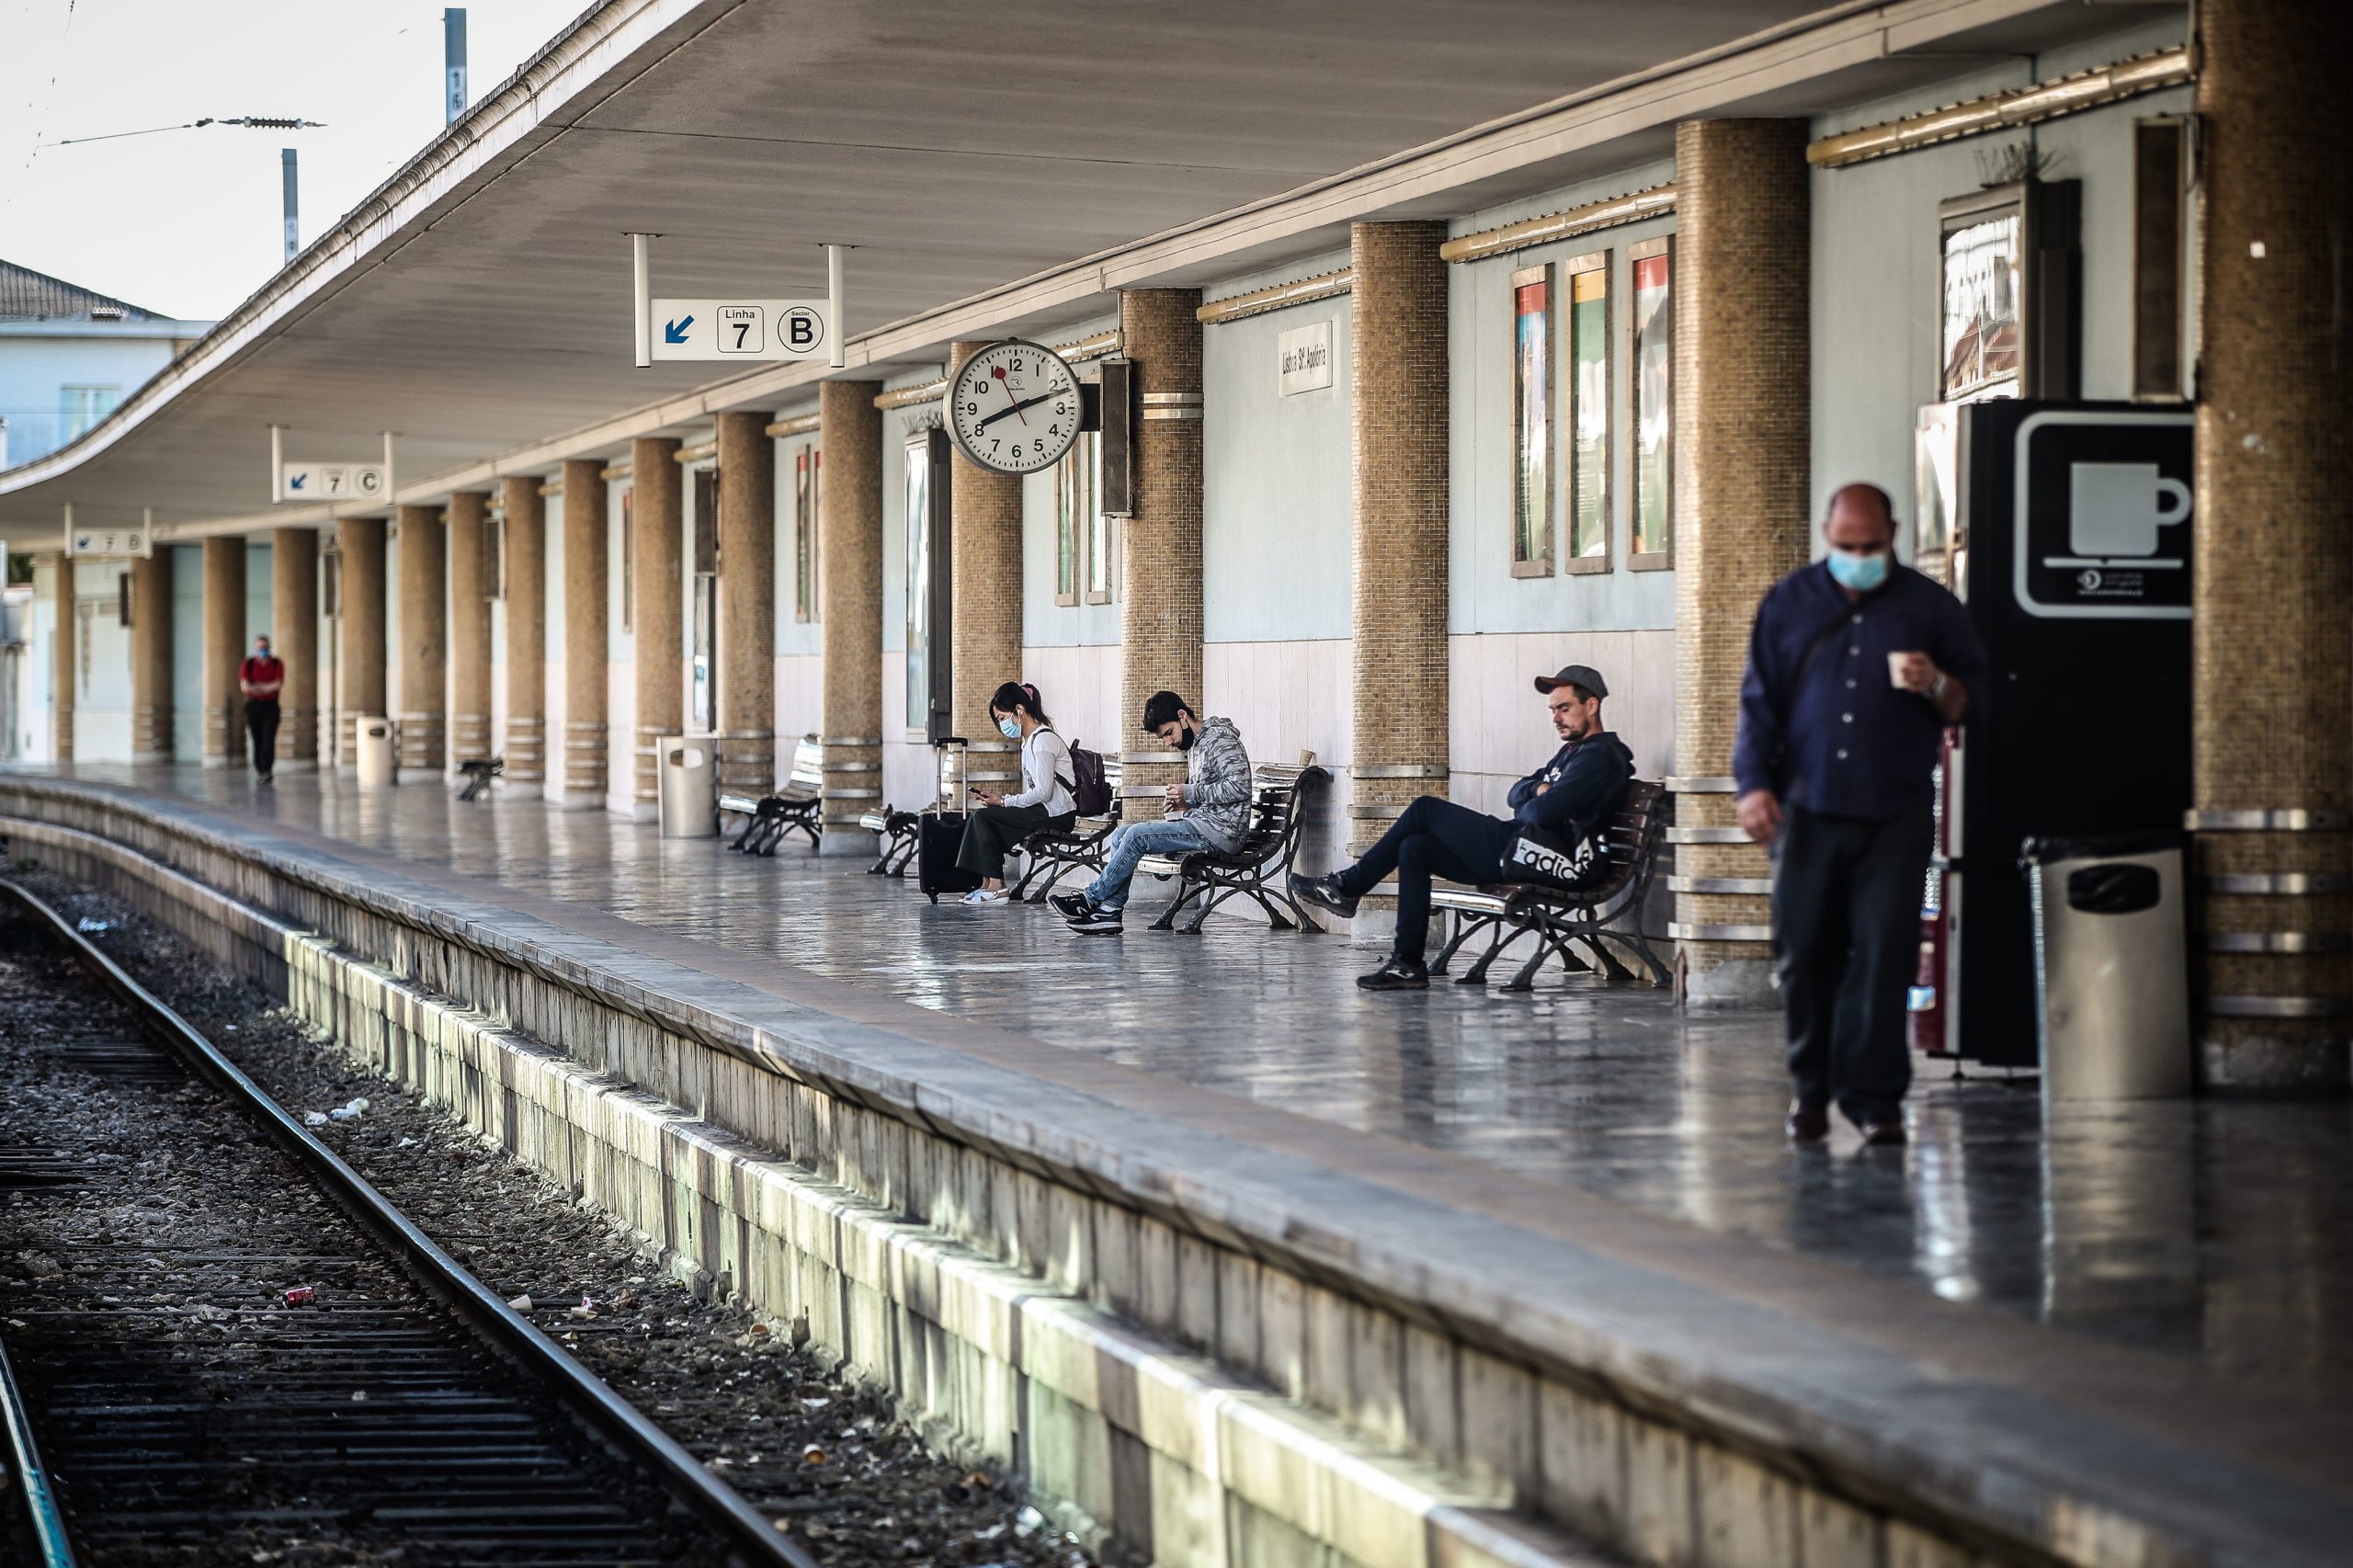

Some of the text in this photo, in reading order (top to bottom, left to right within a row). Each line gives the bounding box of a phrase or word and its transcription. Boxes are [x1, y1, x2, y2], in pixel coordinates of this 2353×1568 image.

[725, 310, 756, 319] Linha
[733, 323, 750, 349] 7
[790, 317, 813, 345] B
[1008, 358, 1023, 372] 12
[1036, 363, 1040, 378] 1
[974, 381, 989, 394] 10
[1048, 379, 1058, 392] 2
[967, 402, 978, 416] 9
[1055, 402, 1066, 415] 3
[974, 424, 984, 437] 8
[1048, 423, 1059, 437] 4
[991, 438, 1001, 452] 7
[1011, 444, 1022, 459] 6
[1033, 438, 1044, 452] 5
[330, 476, 340, 493] 7
[363, 472, 376, 491] C
